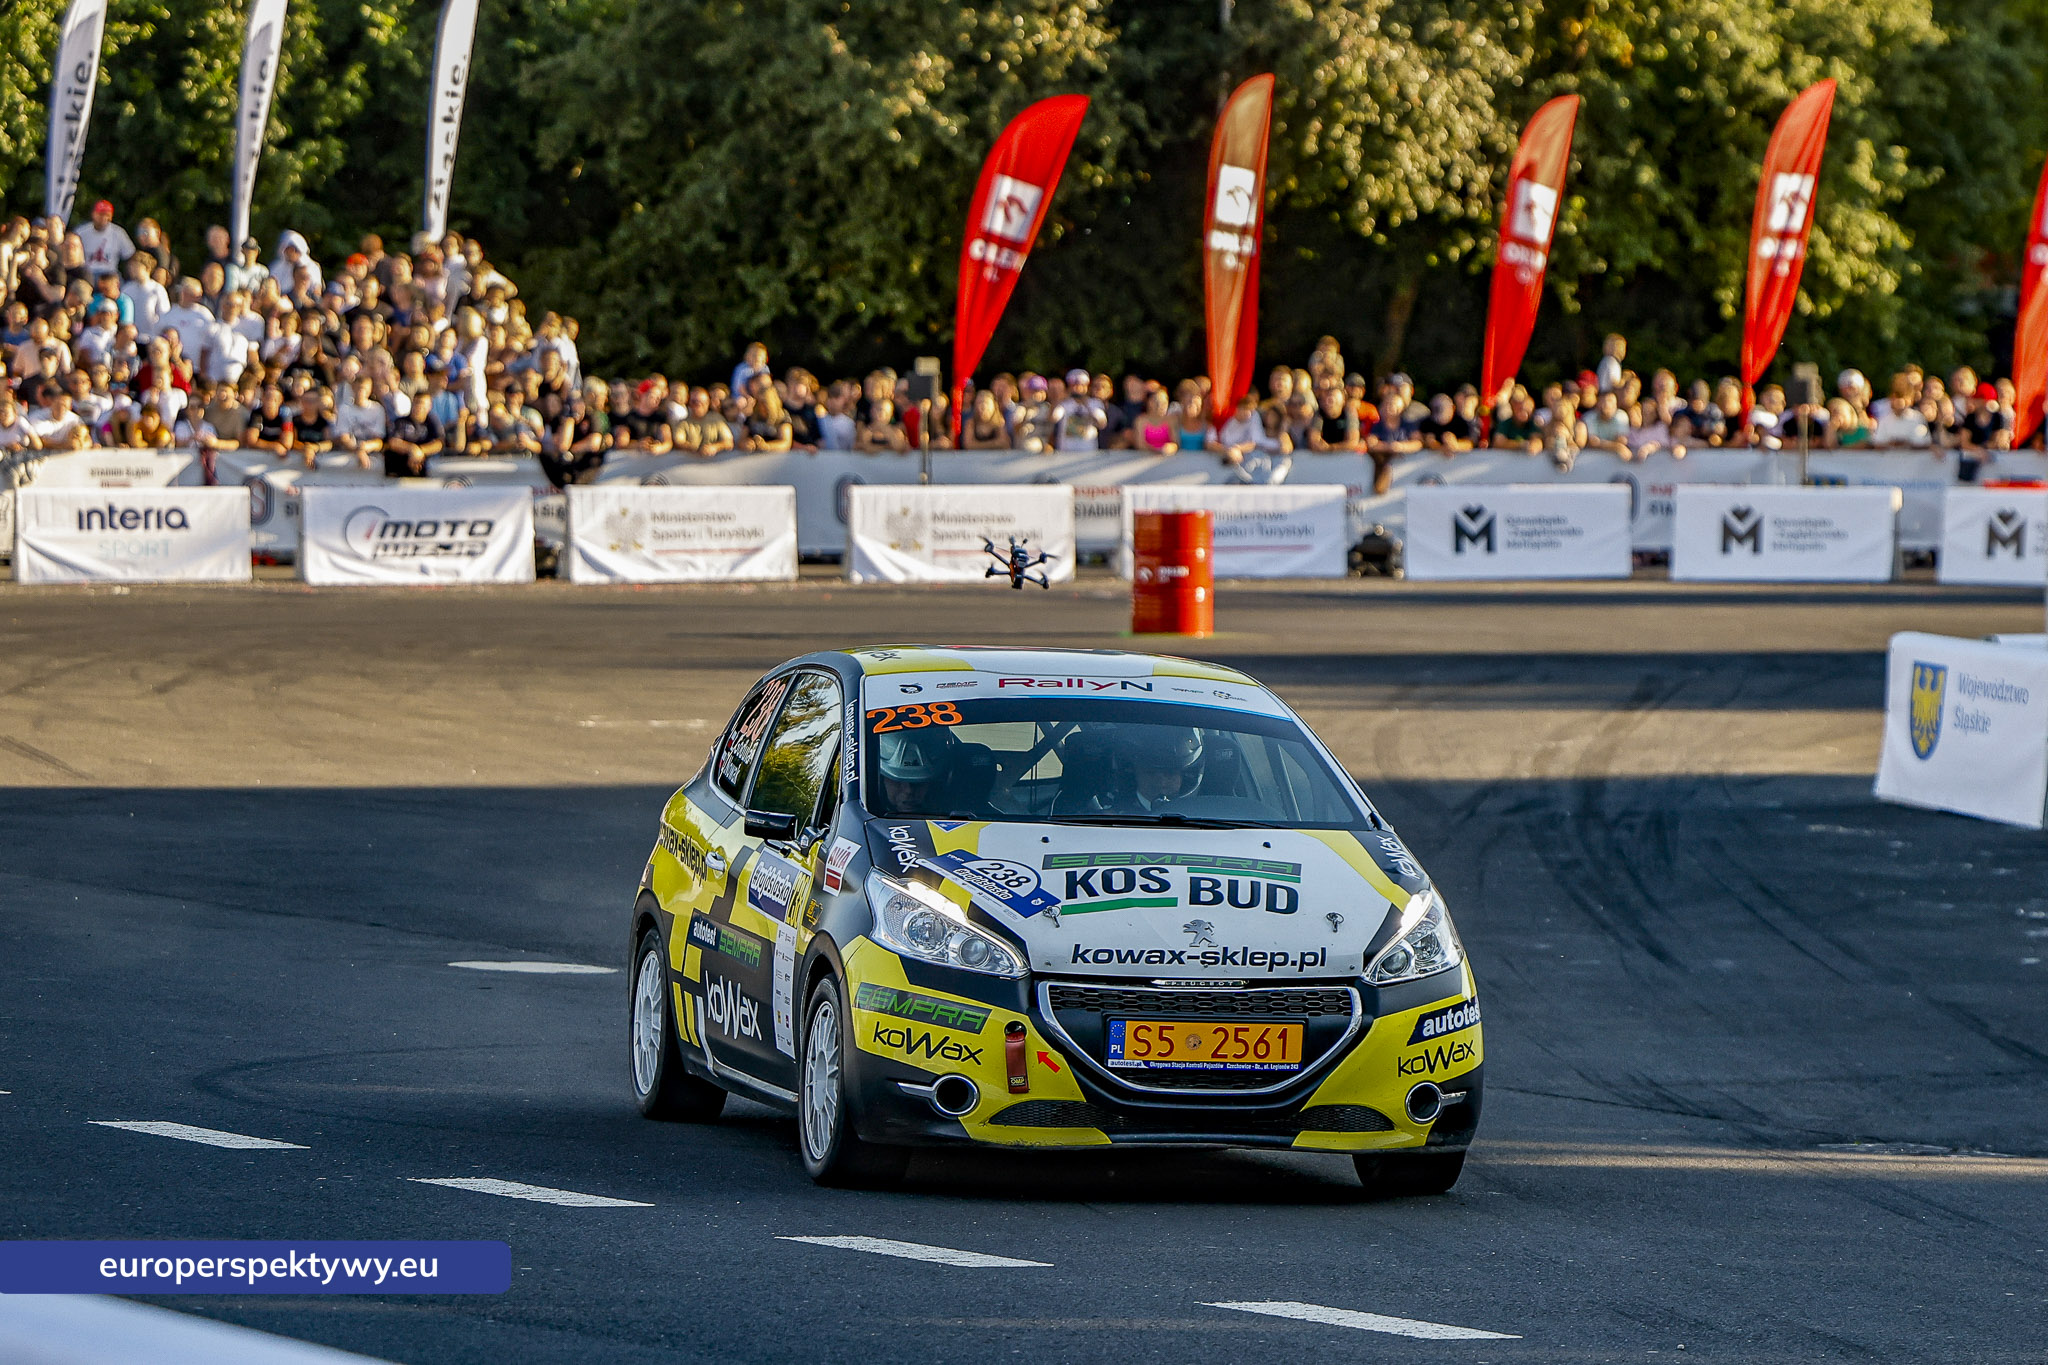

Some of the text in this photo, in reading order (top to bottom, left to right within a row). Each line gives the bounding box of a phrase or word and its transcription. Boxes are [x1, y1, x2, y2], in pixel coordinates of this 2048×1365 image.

[380, 519, 495, 539] MOTO
[1213, 525, 1247, 539] portu
[1214, 510, 1288, 522] inisterstwo
[998, 678, 1153, 692] RallyN
[866, 702, 963, 734] 238
[845, 698, 859, 784] kowax-sklep.pl
[976, 862, 1032, 888] 238
[1050, 854, 1294, 874] SEMPRA
[1065, 866, 1300, 915] KOS BUD
[693, 920, 718, 946] autotest
[719, 927, 763, 968] SEMPRA
[1071, 944, 1327, 972] kowax-sklep.pl
[705, 969, 762, 1042] koWax
[855, 986, 986, 1030] SEMPRA
[1422, 1002, 1480, 1037] autotes
[872, 1021, 984, 1066] koWax
[1111, 1044, 1123, 1054] PL
[1132, 1024, 1289, 1060] S5 2561
[1397, 1039, 1476, 1078] koWax
